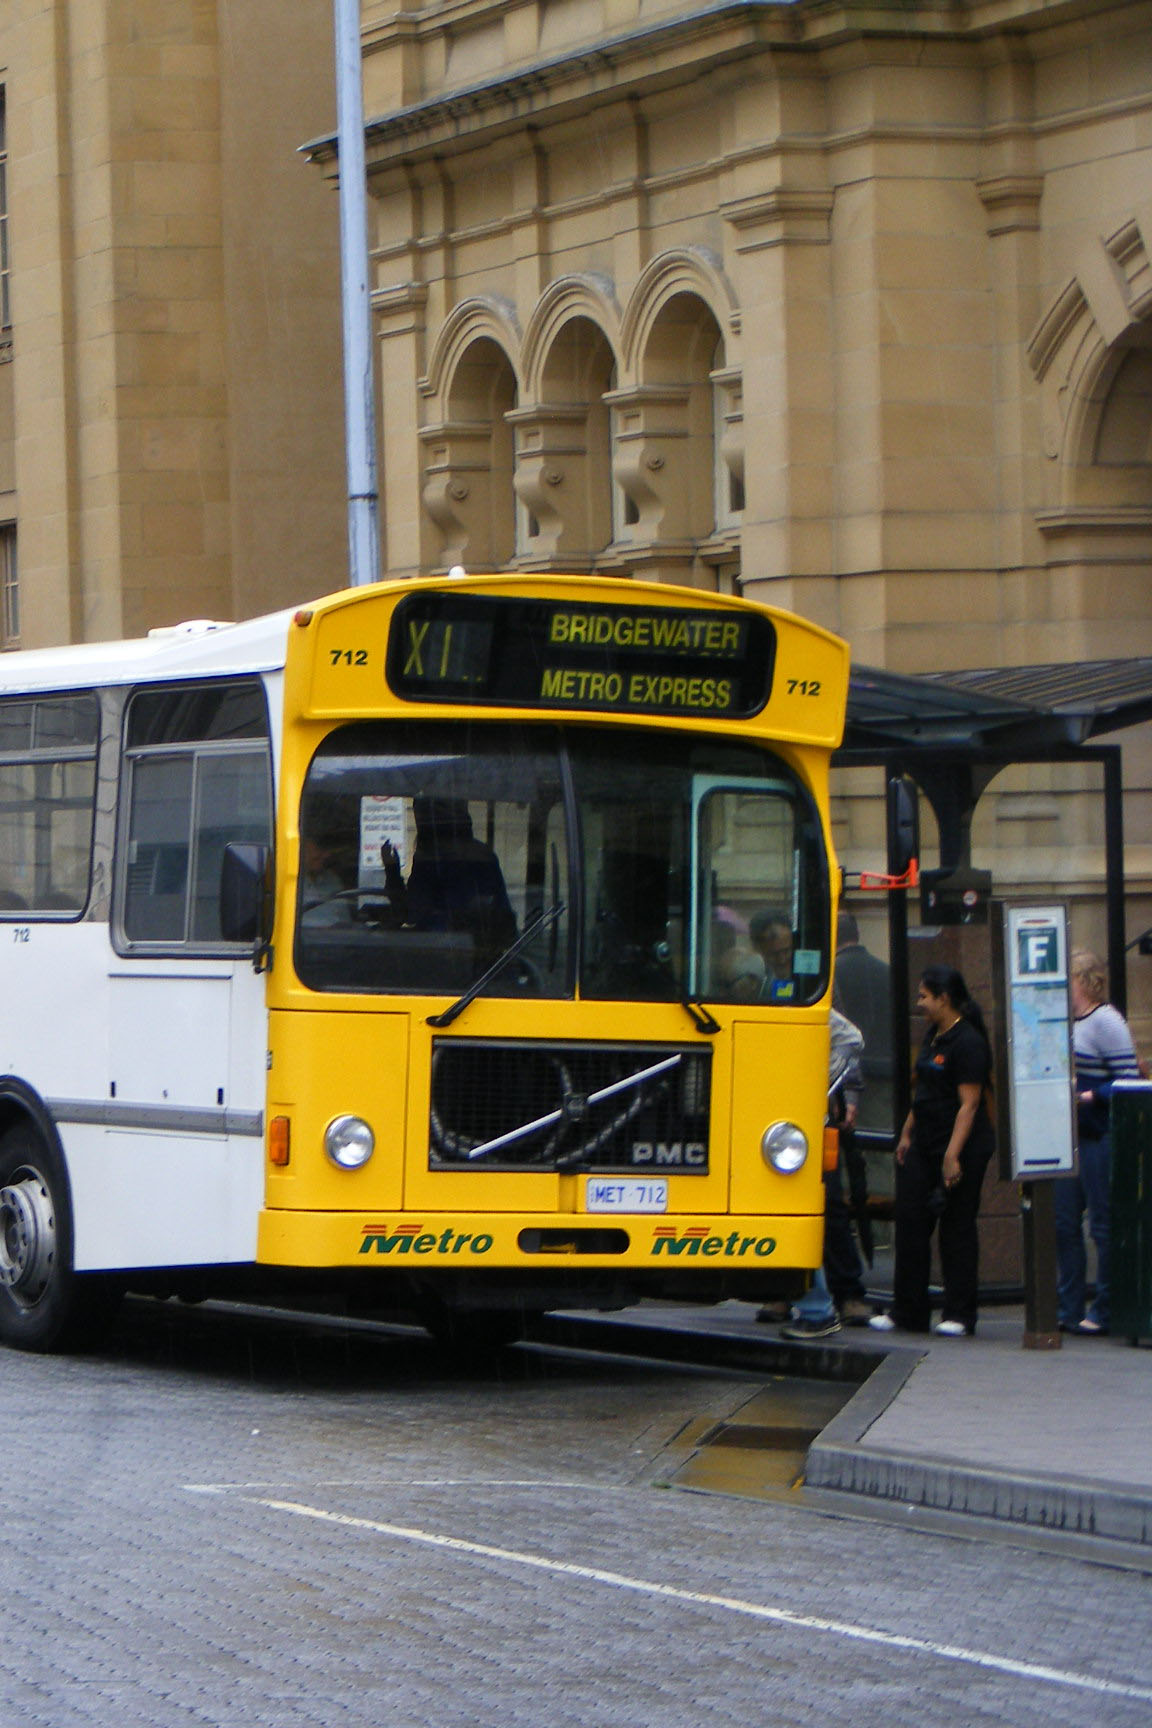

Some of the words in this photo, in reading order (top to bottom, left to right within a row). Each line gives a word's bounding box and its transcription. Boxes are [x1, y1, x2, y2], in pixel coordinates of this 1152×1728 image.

[550, 613, 741, 650] BRIDGEWATER
[330, 649, 369, 666] 712
[541, 669, 623, 700] METRO
[628, 674, 732, 709] EXPRESS
[786, 679, 821, 697] 712
[13, 927, 30, 943] 712
[1028, 936, 1049, 970] F
[632, 1141, 706, 1165] PMC
[594, 1185, 625, 1204] MET
[636, 1185, 666, 1204] 712
[358, 1223, 494, 1255] Metro
[651, 1226, 778, 1257] Metro
